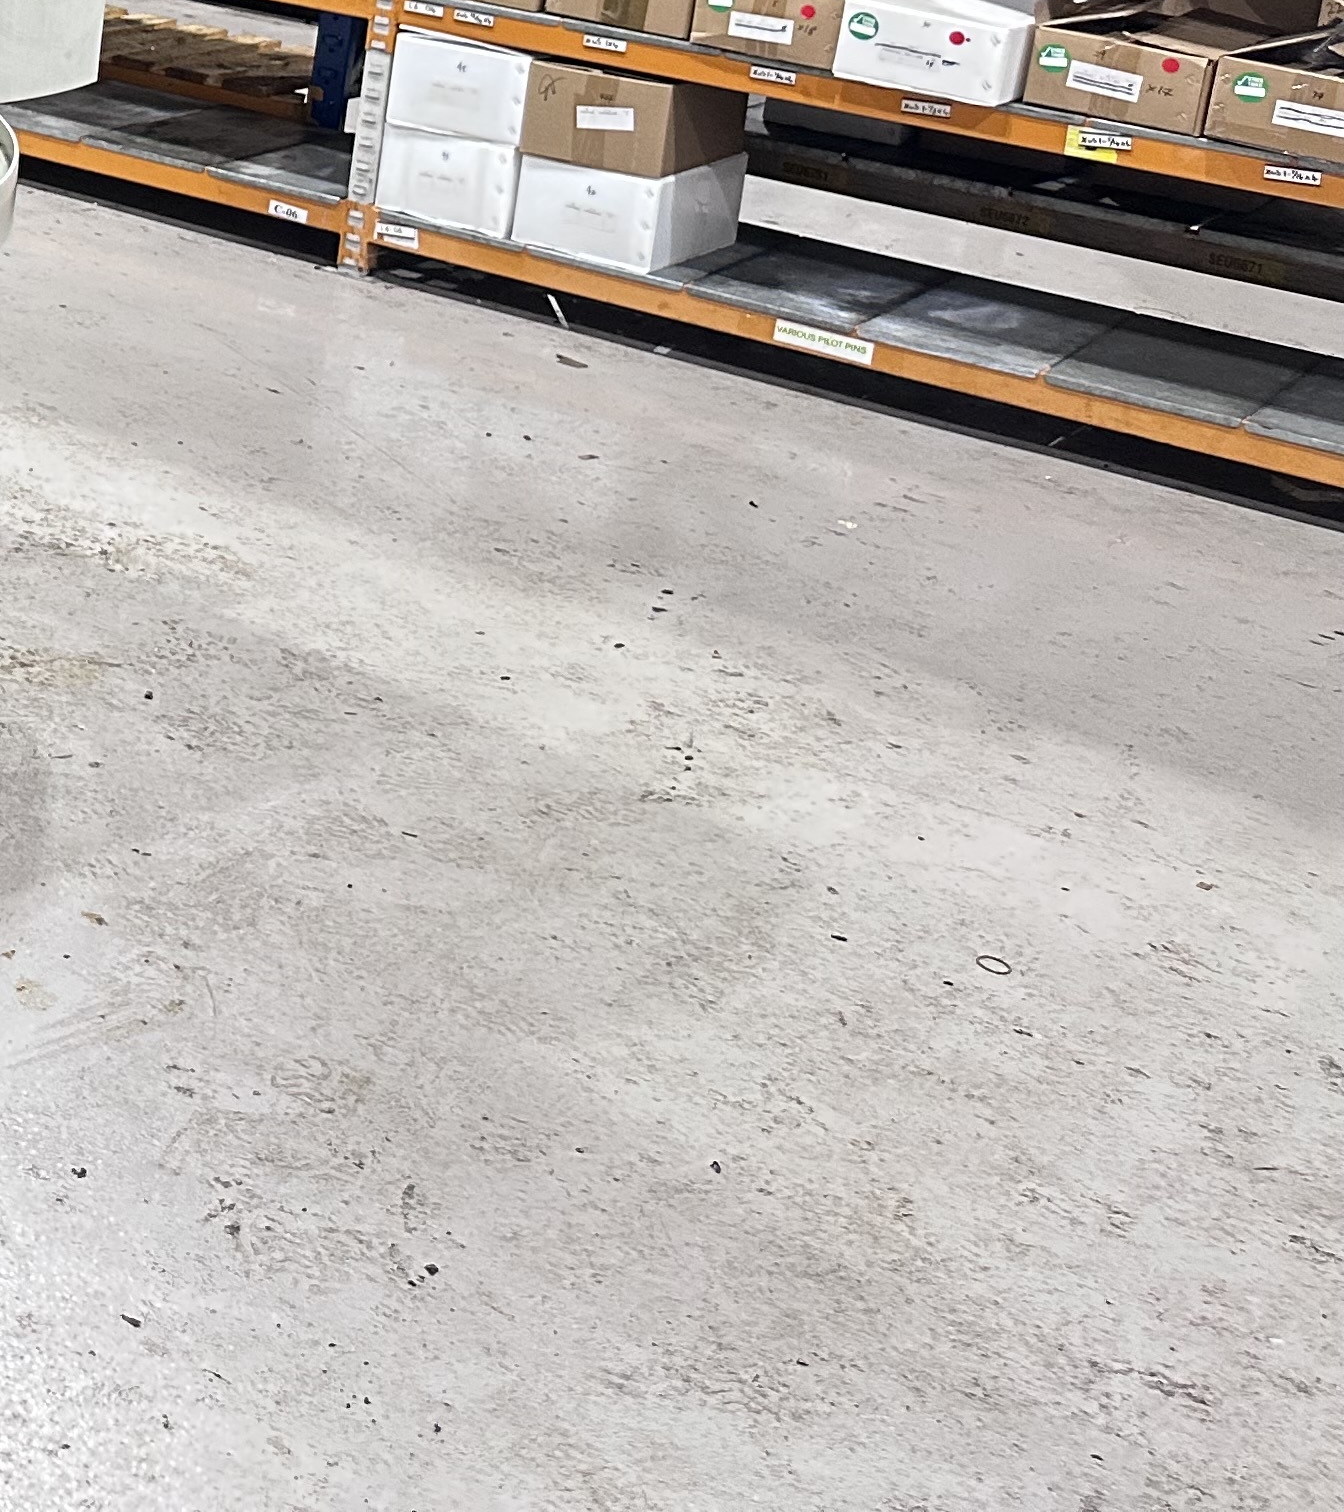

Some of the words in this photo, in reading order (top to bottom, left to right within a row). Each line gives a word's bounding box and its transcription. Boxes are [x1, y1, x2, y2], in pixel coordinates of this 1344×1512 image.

[777, 325, 816, 342] VARIOUS
[817, 335, 844, 348] PILOT
[845, 342, 868, 355] PINS
